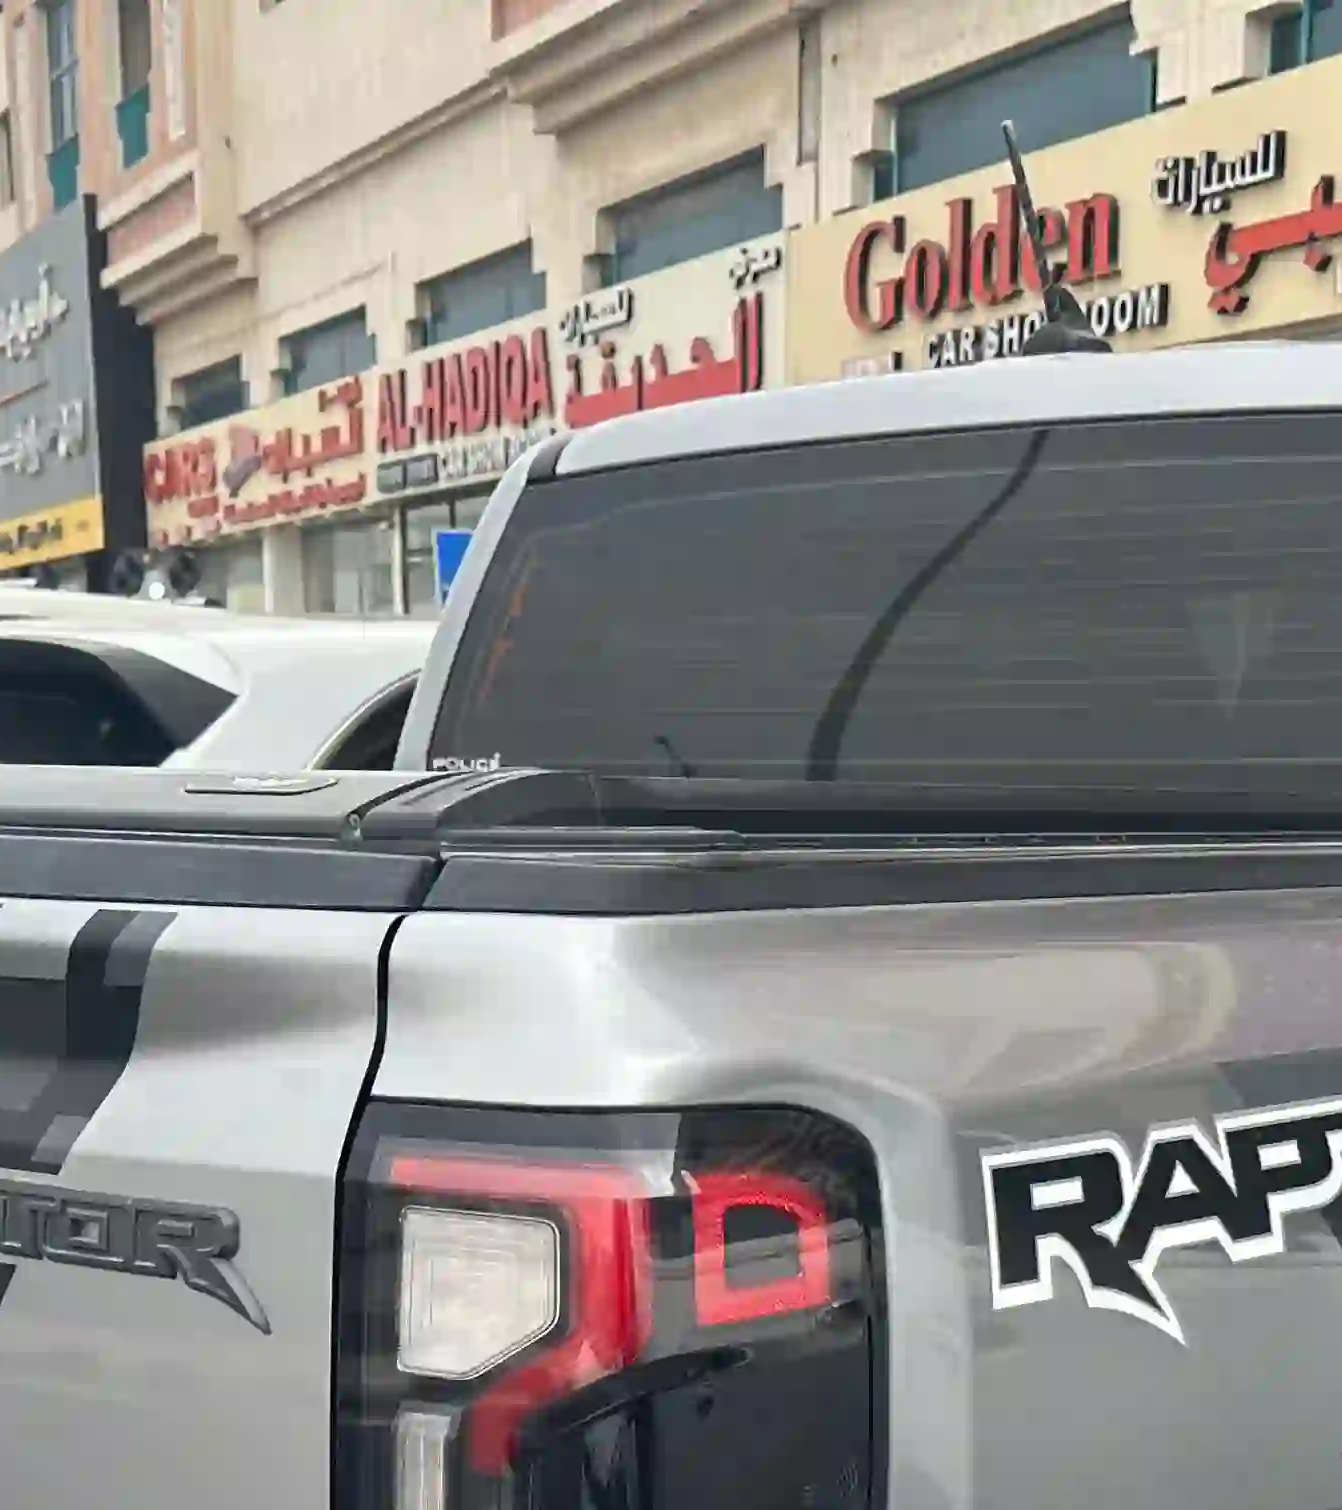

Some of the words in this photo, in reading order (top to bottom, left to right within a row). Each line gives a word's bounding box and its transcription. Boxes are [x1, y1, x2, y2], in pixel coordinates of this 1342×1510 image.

[1152, 129, 1287, 216] للسيارات
[843, 184, 1121, 332] Golden
[926, 325, 976, 368] CAR
[982, 282, 1170, 360] SHOOOM
[377, 326, 556, 454] AL-HADIQA
